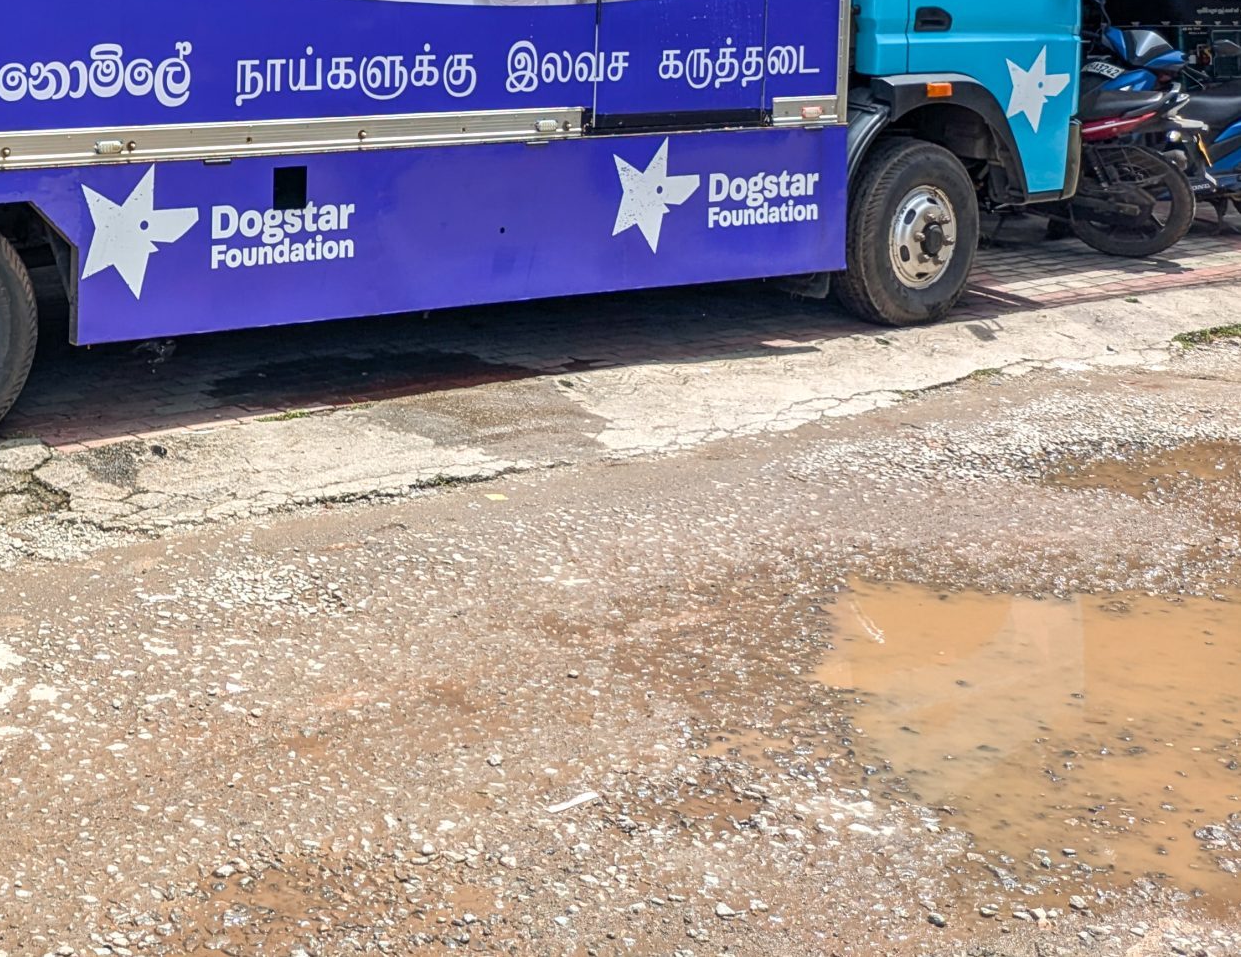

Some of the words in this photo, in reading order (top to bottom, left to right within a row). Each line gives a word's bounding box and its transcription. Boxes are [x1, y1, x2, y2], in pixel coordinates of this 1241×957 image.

[235, 43, 477, 106] நாய்களுக்கு
[506, 41, 629, 92] இலவச
[659, 37, 819, 89] கருத்தடை
[708, 170, 819, 207] Dogstar
[211, 201, 355, 244] Dogstar
[708, 199, 819, 228] Foundation
[211, 235, 354, 269] Foundation
